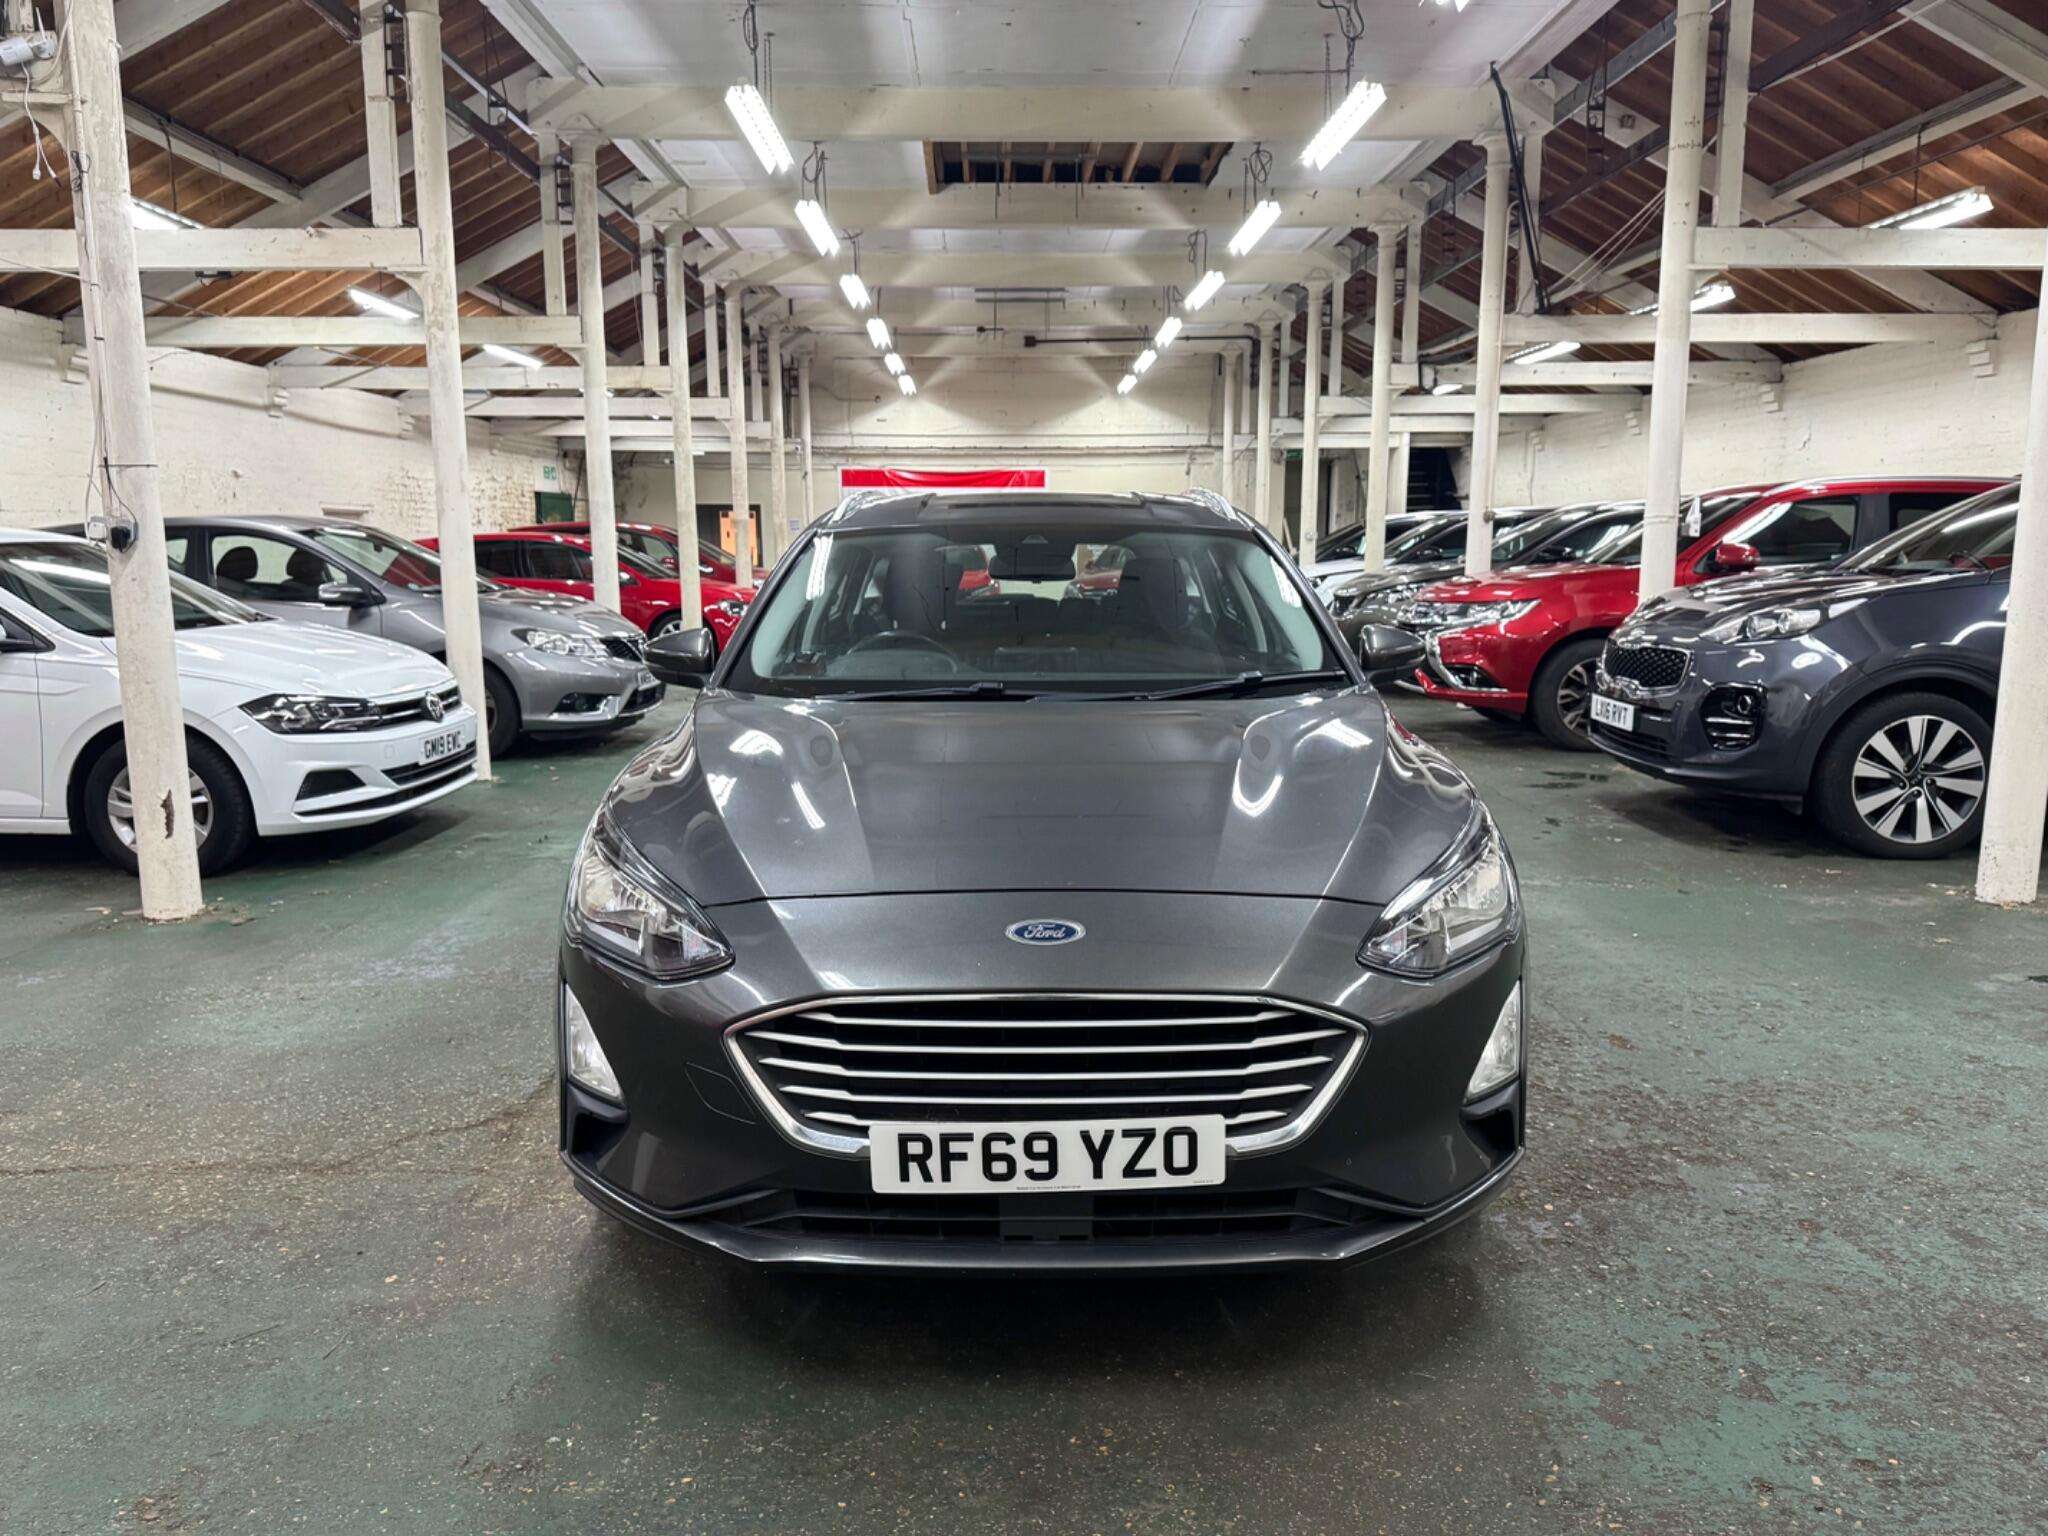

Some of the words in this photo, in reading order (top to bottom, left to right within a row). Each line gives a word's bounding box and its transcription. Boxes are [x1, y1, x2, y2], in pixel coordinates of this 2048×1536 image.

[1023, 923, 1066, 939] Ford
[897, 1131, 1058, 1184] RF69
[1079, 1126, 1199, 1180] YZO
